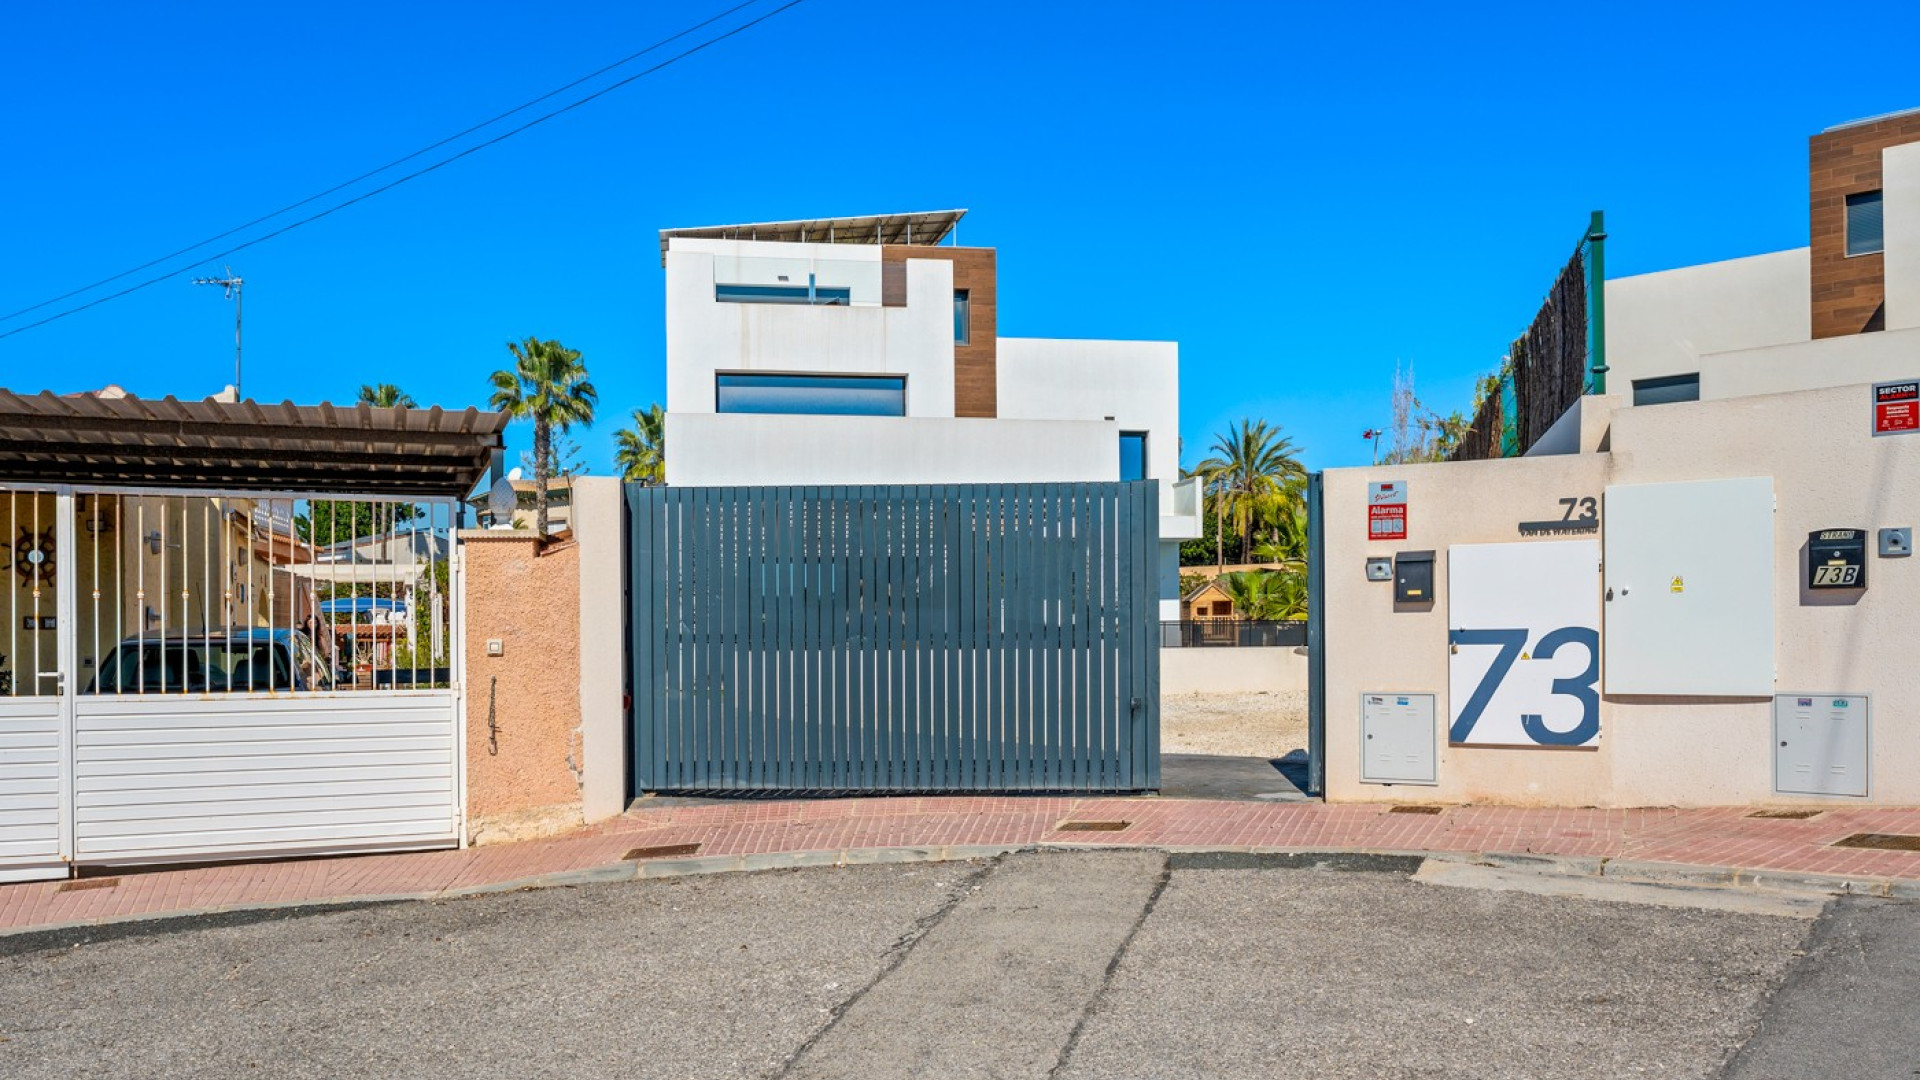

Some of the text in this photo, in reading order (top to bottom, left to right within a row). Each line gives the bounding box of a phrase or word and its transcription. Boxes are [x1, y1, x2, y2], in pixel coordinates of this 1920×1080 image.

[1879, 385, 1916, 395] SECTOR
[1371, 505, 1404, 514] Alarma
[1558, 497, 1597, 521] 73
[1816, 567, 1857, 584] 73B
[1449, 626, 1600, 746] 73
